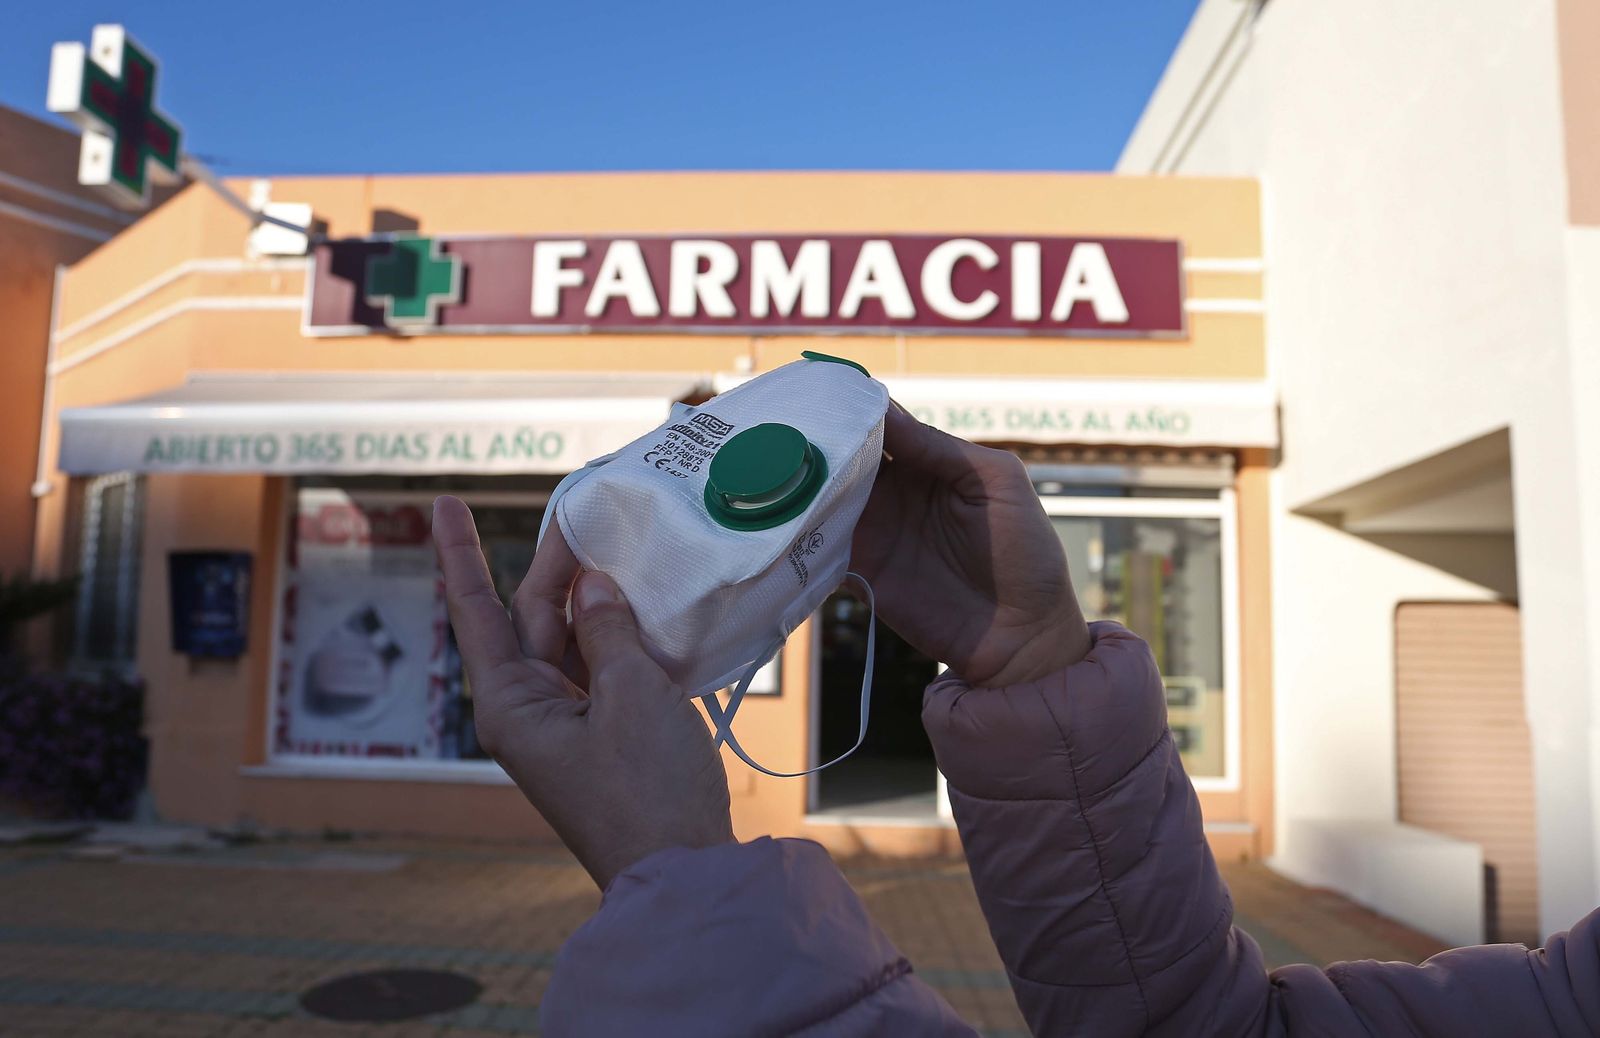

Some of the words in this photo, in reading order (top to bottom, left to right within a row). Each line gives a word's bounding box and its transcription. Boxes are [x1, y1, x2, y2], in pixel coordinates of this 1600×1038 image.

[531, 238, 1130, 322] FARMACIA
[693, 414, 731, 434] MSA
[946, 407, 996, 430] 365
[1005, 409, 1074, 431] DIAS
[1082, 410, 1113, 431] AL
[1125, 407, 1191, 434] AÑO
[144, 433, 279, 464] ABIERTO
[288, 432, 342, 462] 365
[355, 432, 430, 461] DIAS
[439, 432, 476, 460] AL
[486, 425, 564, 460] AÑO
[653, 444, 673, 456] FFP
[664, 441, 703, 465] 10128875
[666, 433, 681, 441] EN
[681, 439, 715, 459] 149:2001
